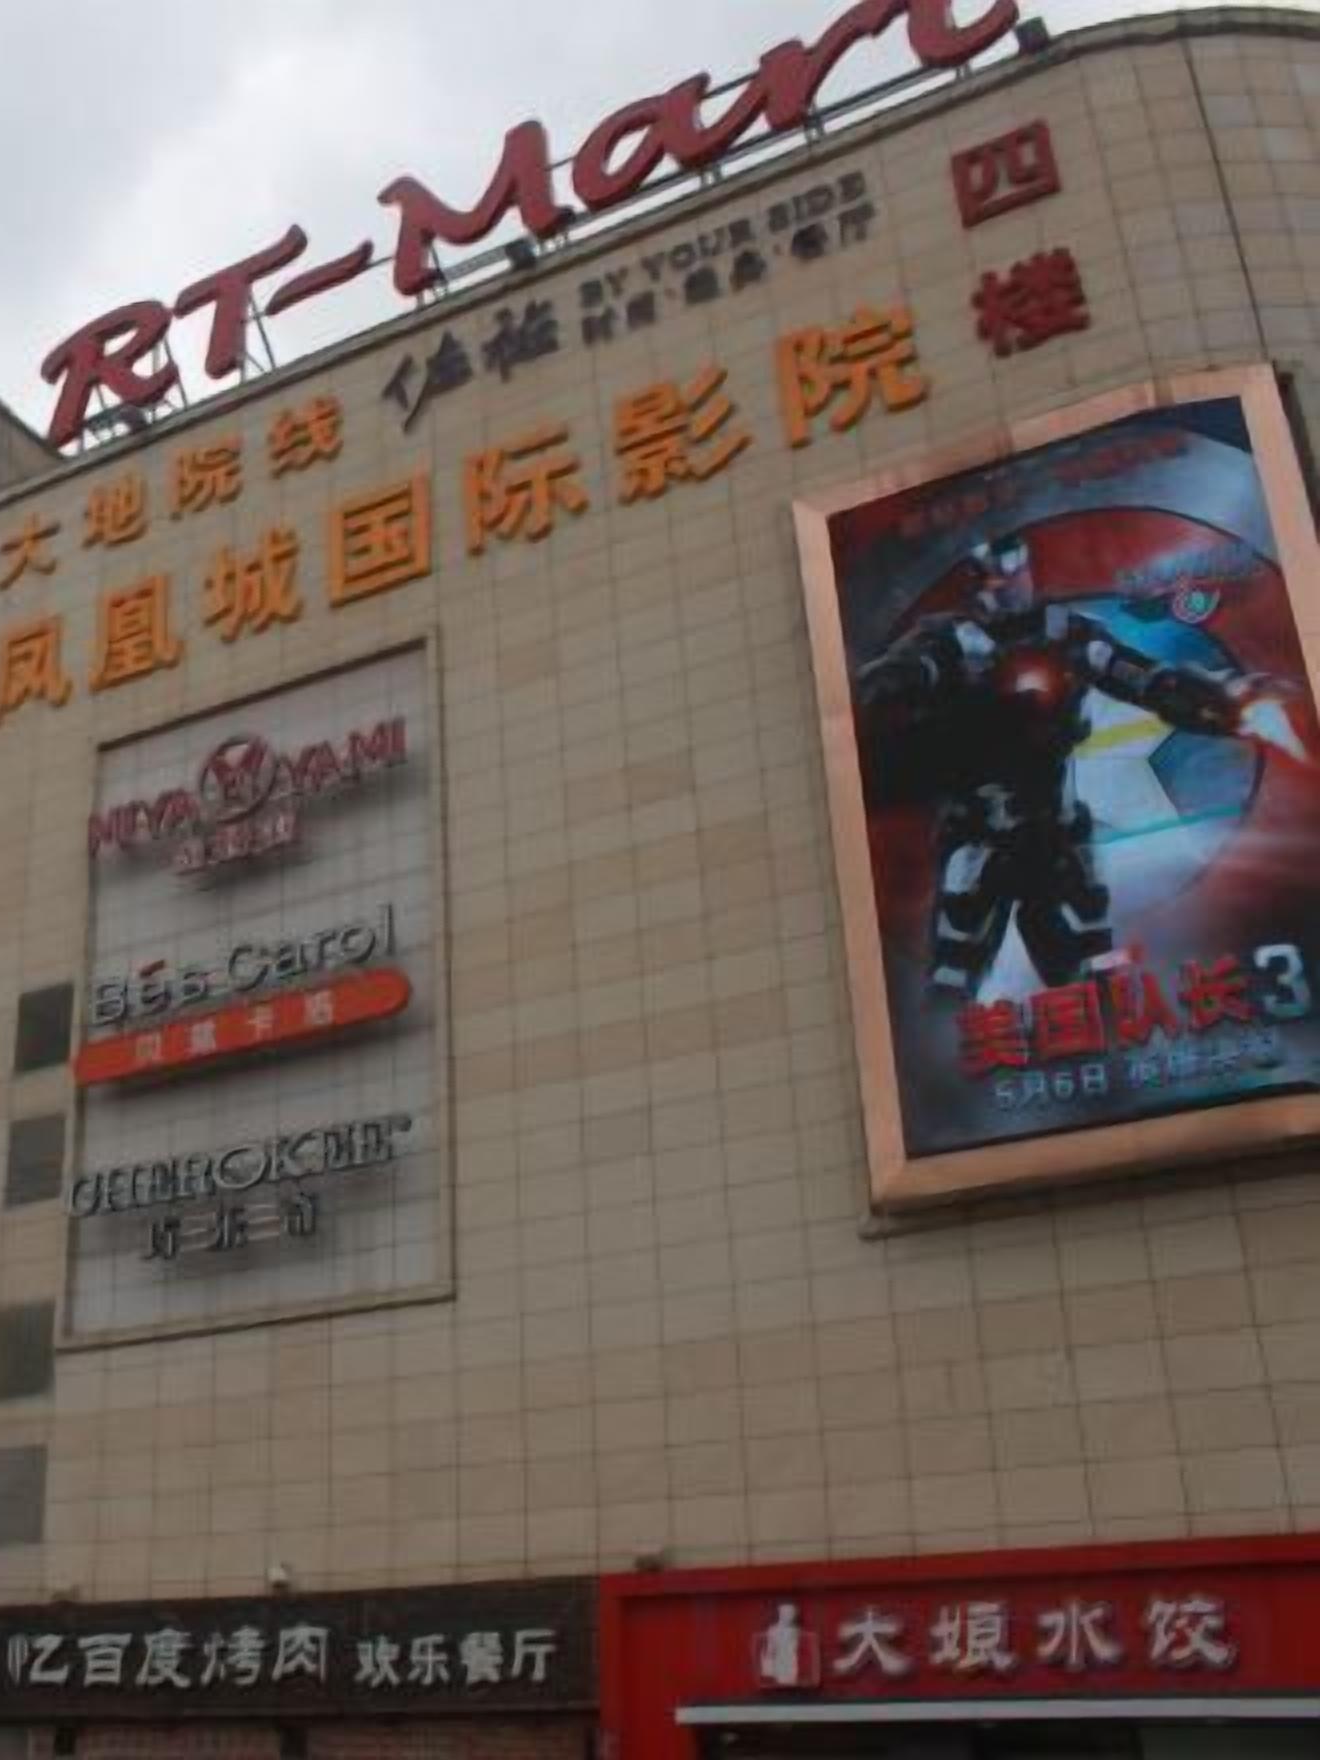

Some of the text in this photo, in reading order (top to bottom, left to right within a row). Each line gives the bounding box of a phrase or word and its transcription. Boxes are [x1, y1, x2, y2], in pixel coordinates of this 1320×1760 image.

[41, 0, 1020, 446] RT-Mart
[642, 217, 756, 281] YOUR
[768, 171, 867, 233] SIDE
[950, 118, 1092, 358] 四楼
[228, 903, 396, 991] Carol
[7, 1623, 329, 1688] 忆百度烤肉
[354, 1629, 557, 1687] 欢乐餐厅
